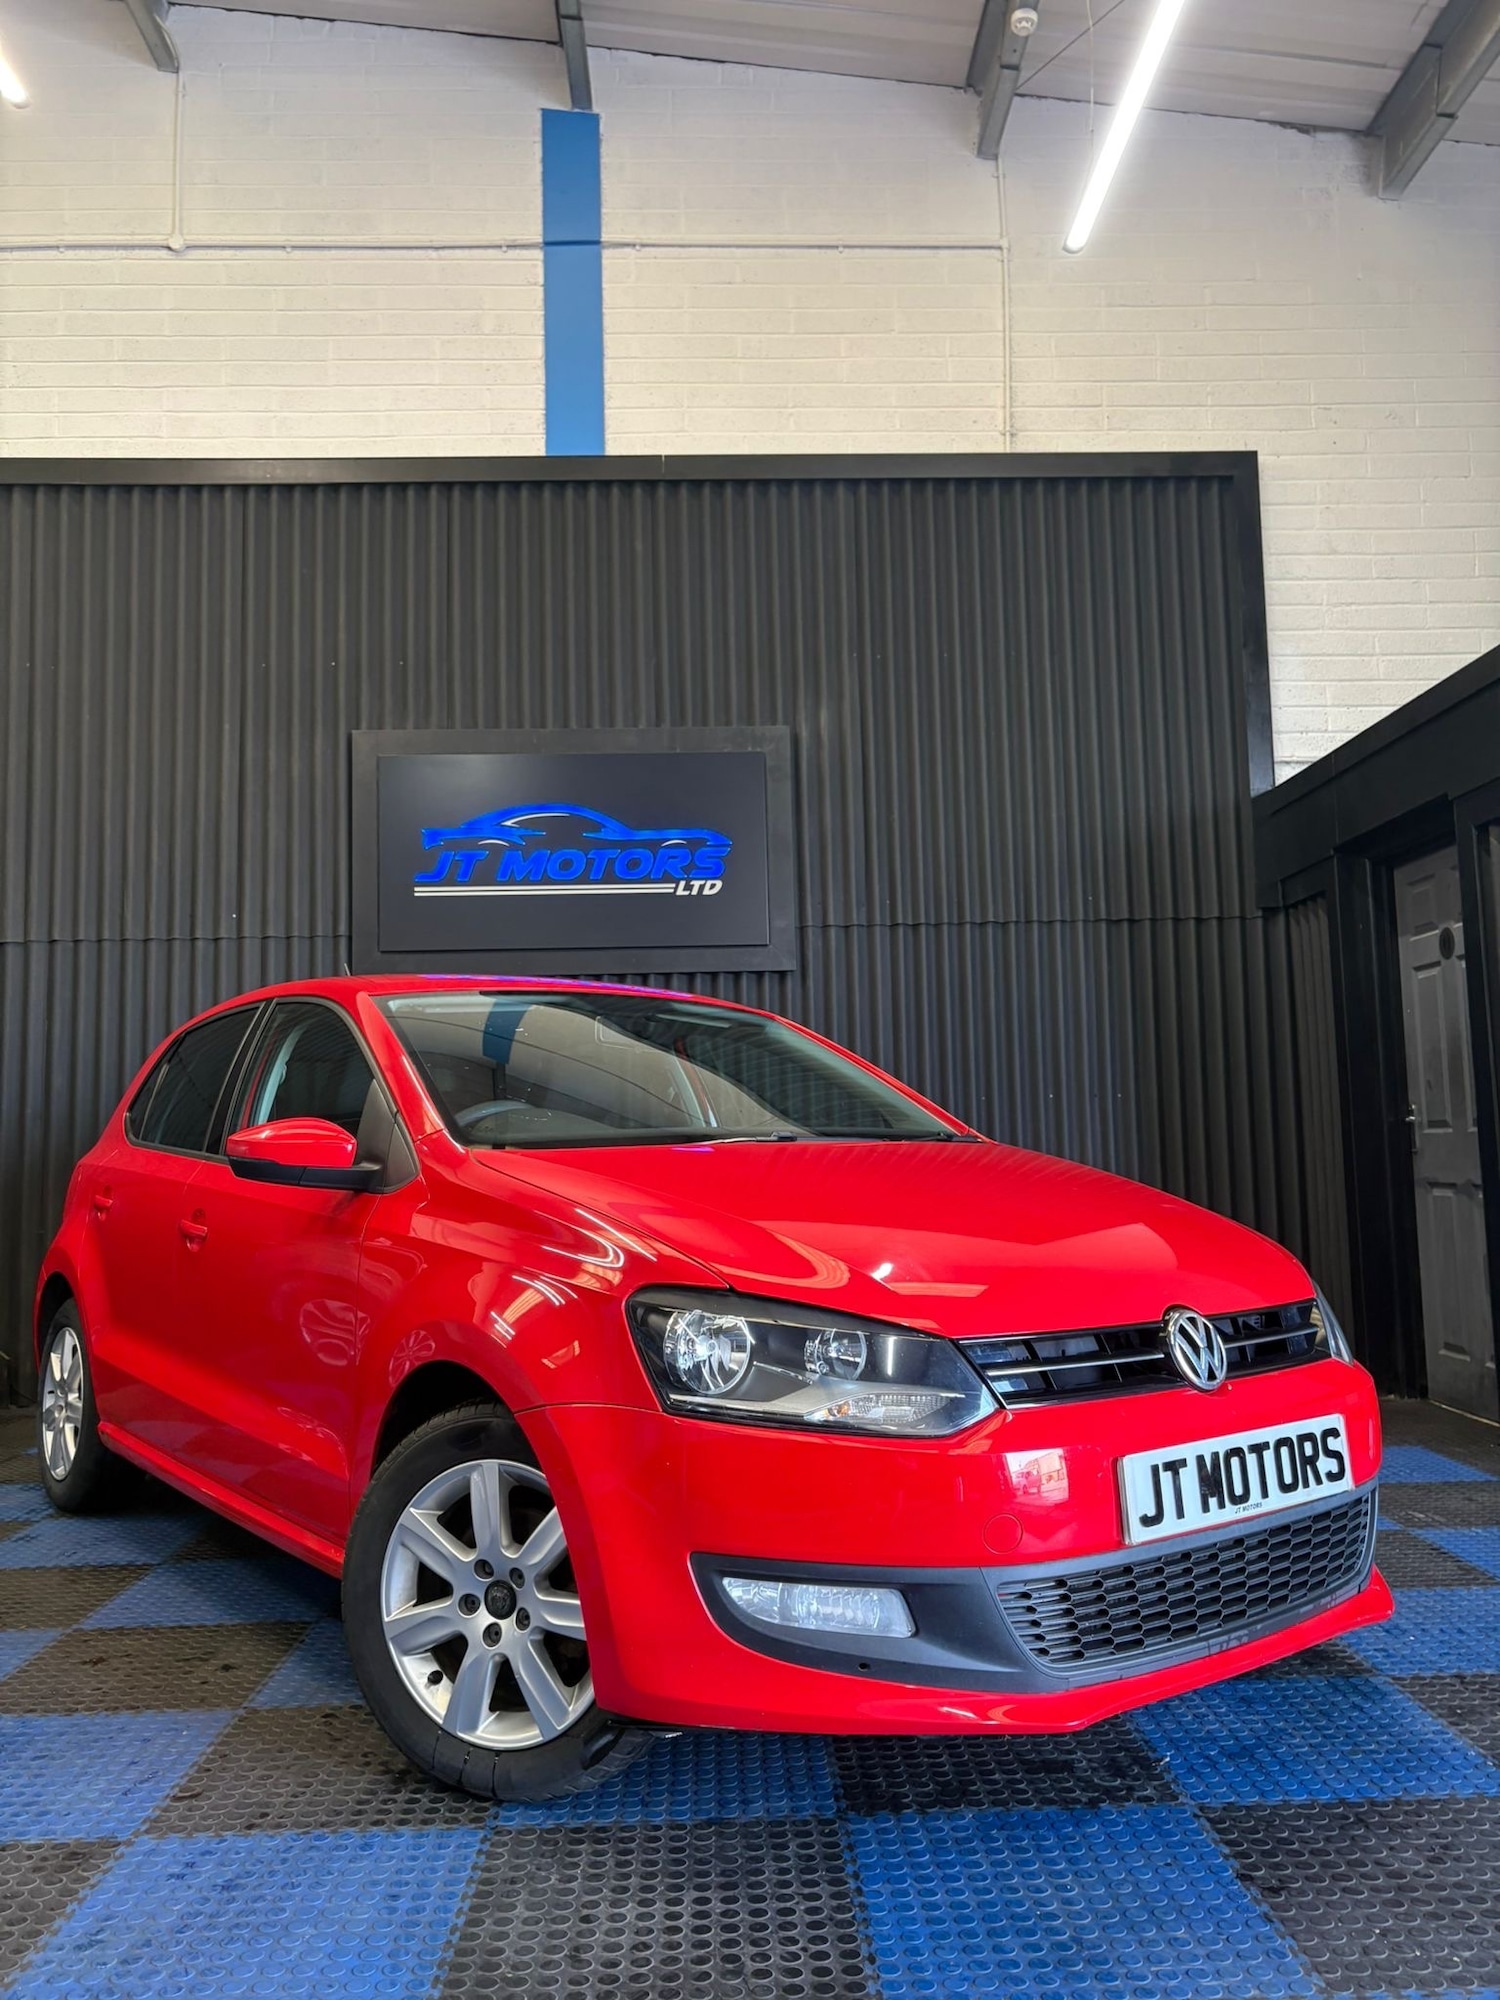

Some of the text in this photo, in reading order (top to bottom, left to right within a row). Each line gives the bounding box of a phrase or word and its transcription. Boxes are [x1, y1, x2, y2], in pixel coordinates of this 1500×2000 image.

[414, 848, 731, 881] JT MOTORS
[675, 880, 723, 896] LTD
[1139, 1427, 1346, 1528] JT MOTORS
[1235, 1502, 1263, 1514] JT MOTORS
